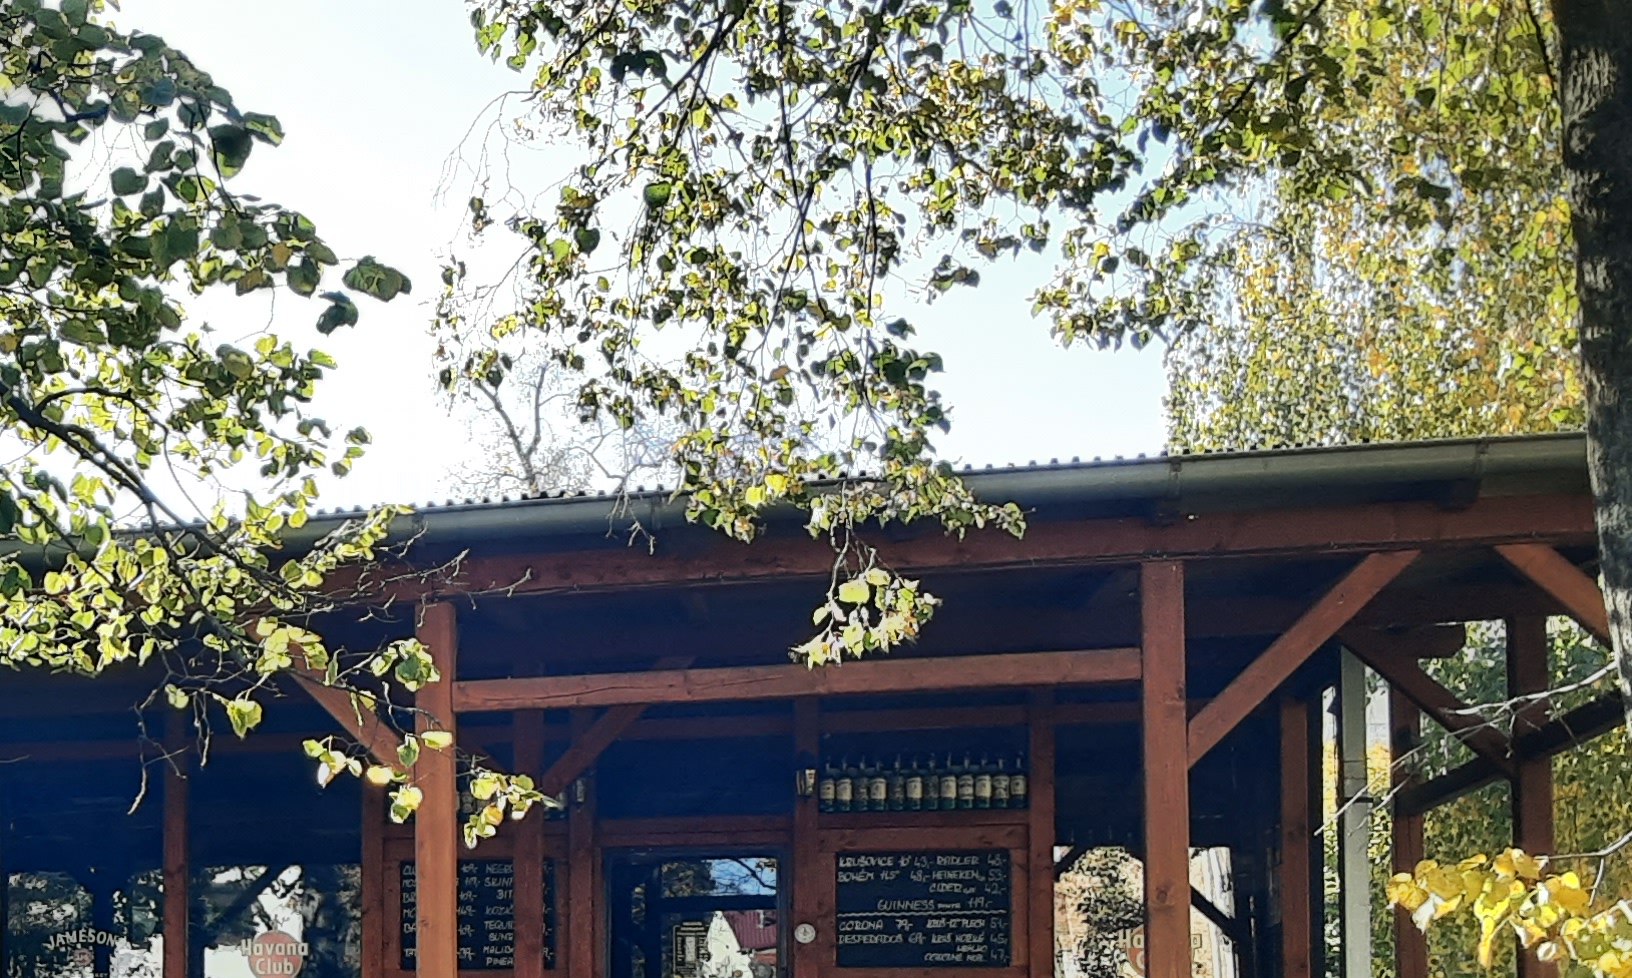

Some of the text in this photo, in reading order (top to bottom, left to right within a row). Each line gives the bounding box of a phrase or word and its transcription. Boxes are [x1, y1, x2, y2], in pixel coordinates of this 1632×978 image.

[877, 899, 935, 910] GUINNESS
[839, 920, 884, 931] CORONA
[49, 928, 119, 951] JAMESON
[242, 939, 309, 956] Havana
[255, 957, 294, 975] Club
